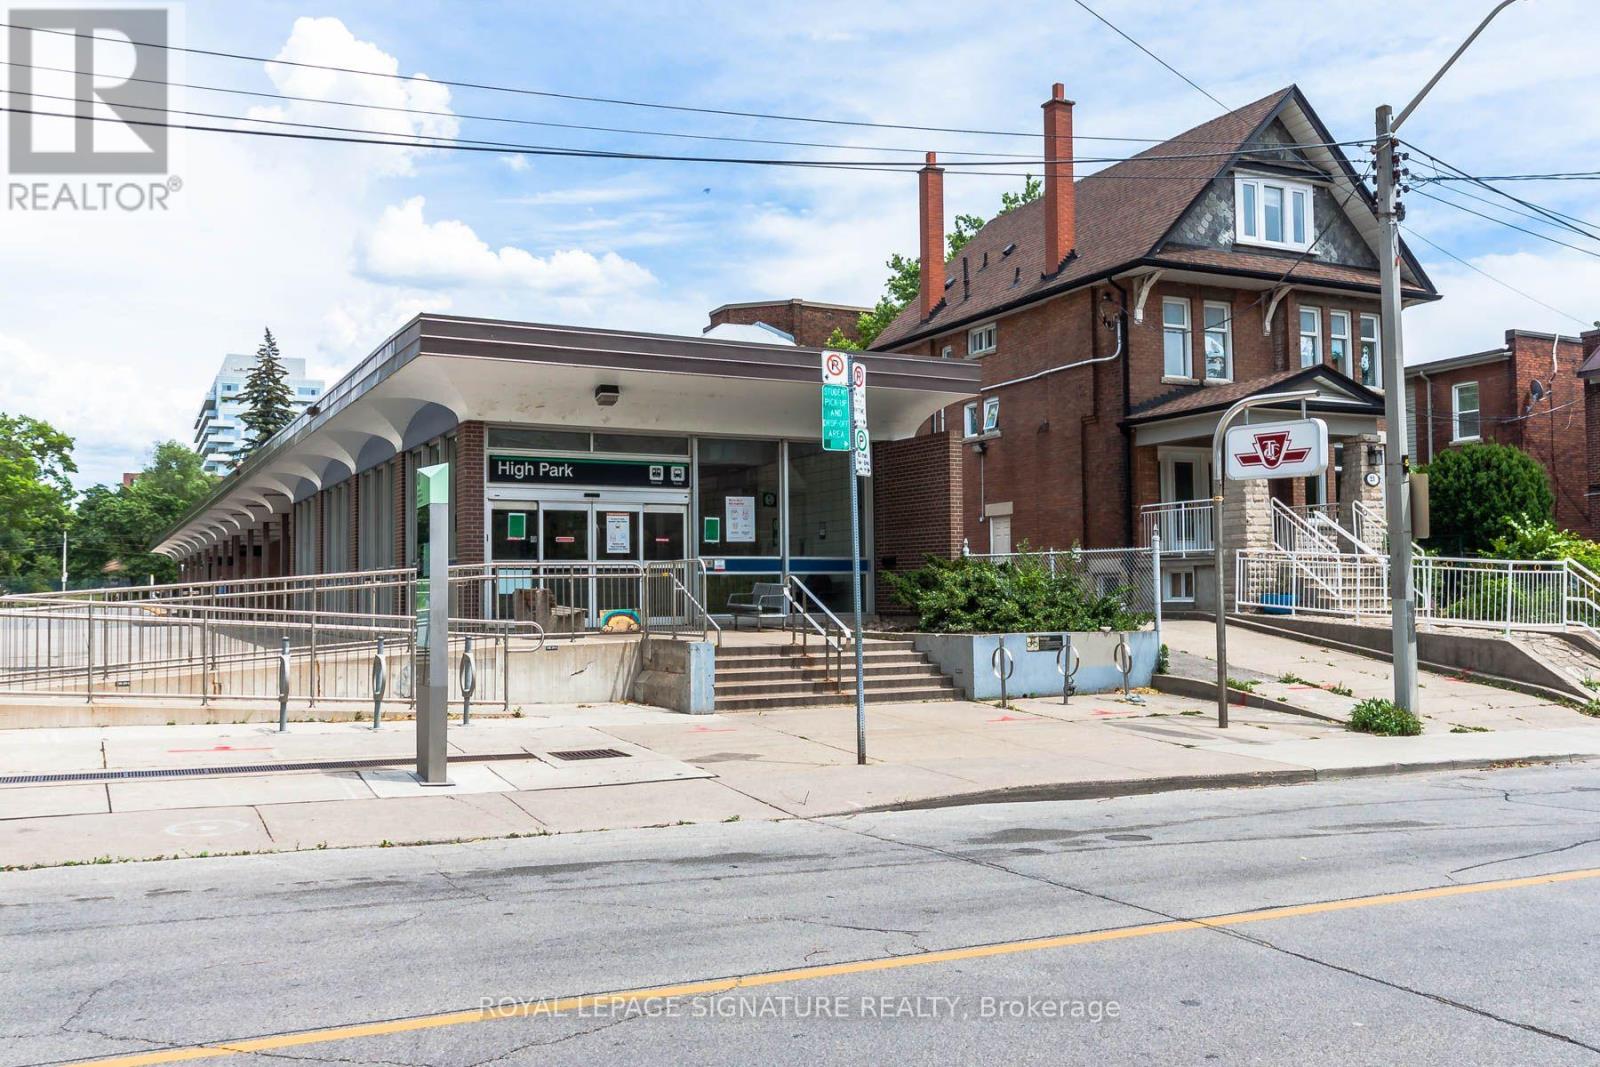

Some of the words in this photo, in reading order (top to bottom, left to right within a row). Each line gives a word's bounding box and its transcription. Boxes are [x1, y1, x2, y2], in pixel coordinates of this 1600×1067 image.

[830, 409, 842, 417] AND
[828, 430, 845, 438] AREA
[498, 461, 534, 479] High
[539, 462, 574, 478] Park
